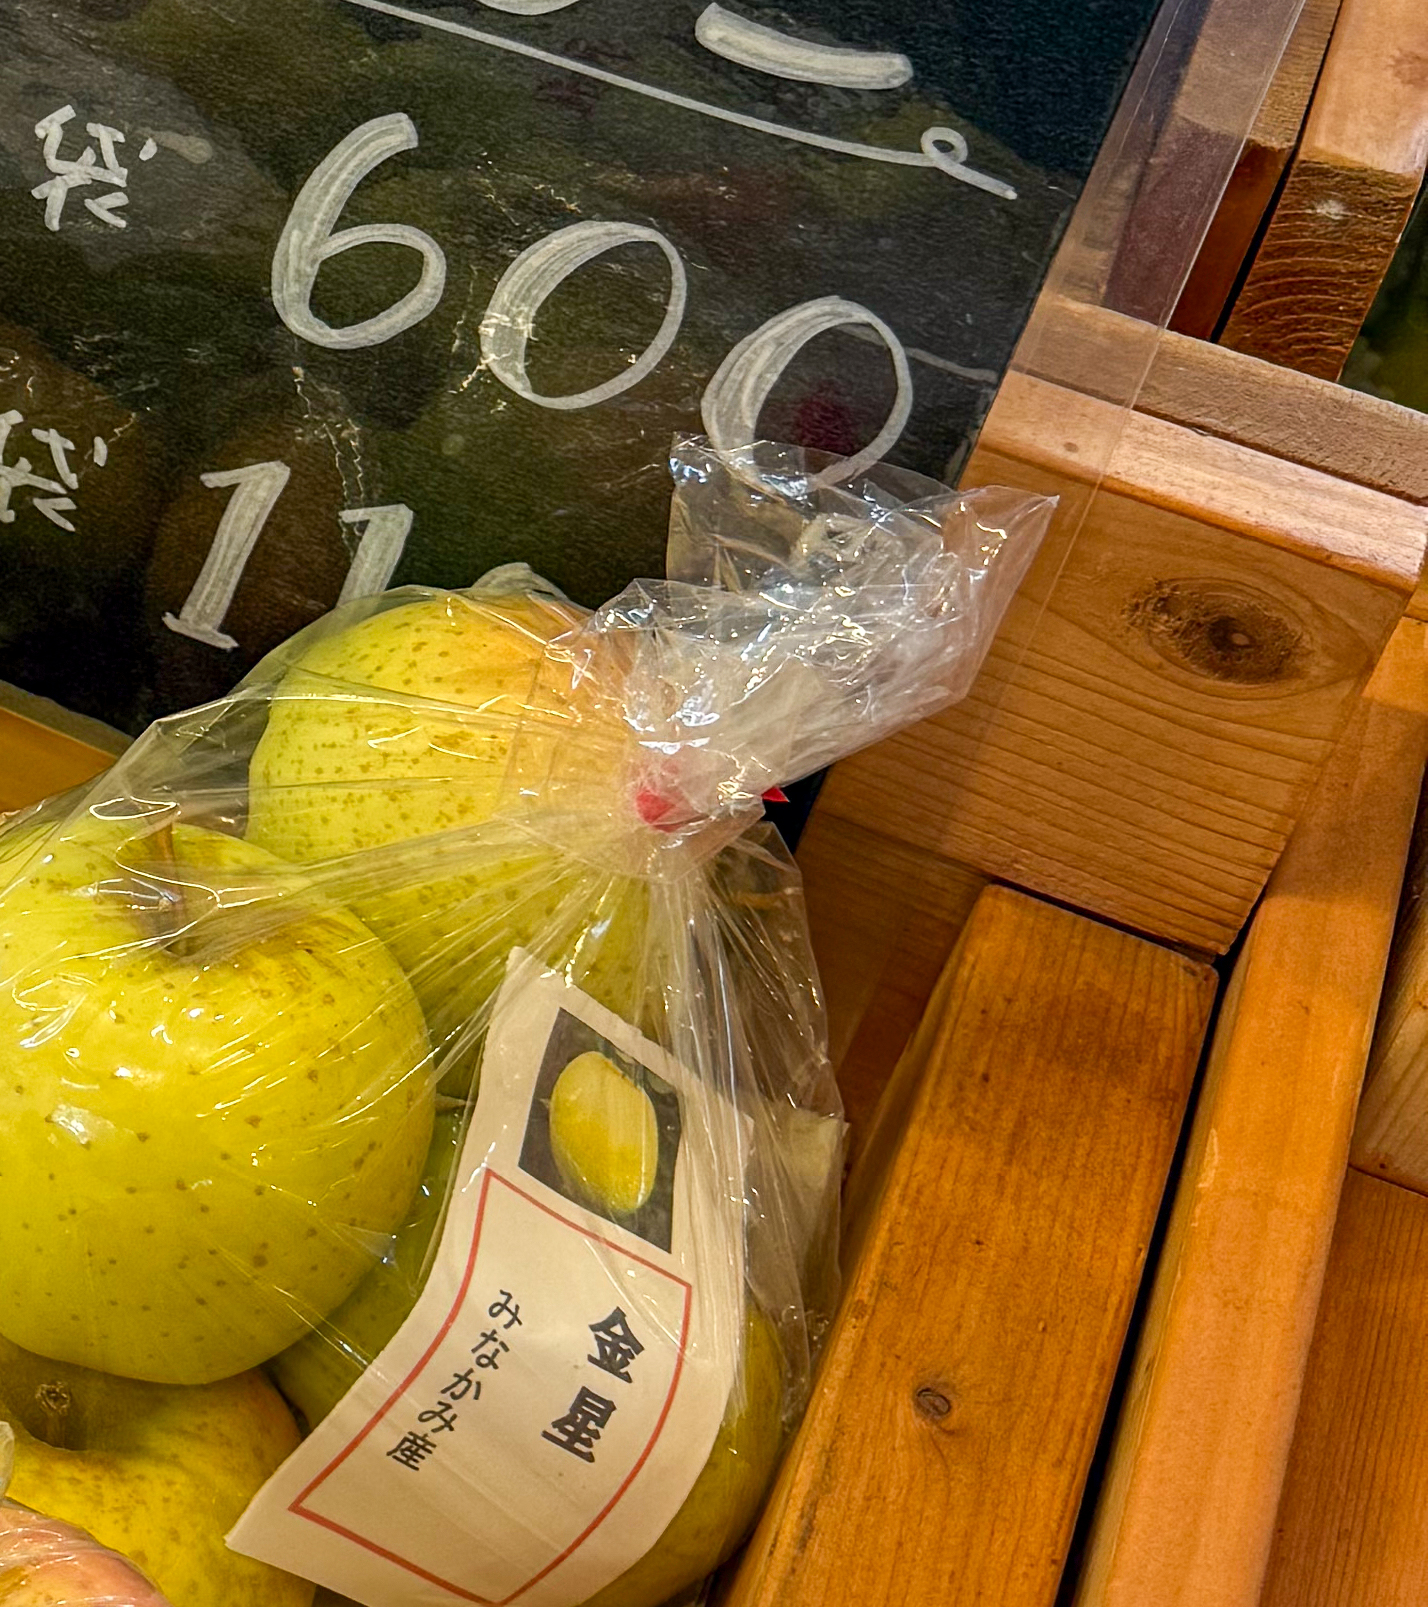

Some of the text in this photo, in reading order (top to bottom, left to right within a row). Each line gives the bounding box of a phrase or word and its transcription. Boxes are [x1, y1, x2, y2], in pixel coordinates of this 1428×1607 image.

[270, 111, 914, 485] 600
[386, 1289, 524, 1472] みなかみ産
[541, 1306, 646, 1464] 金星
